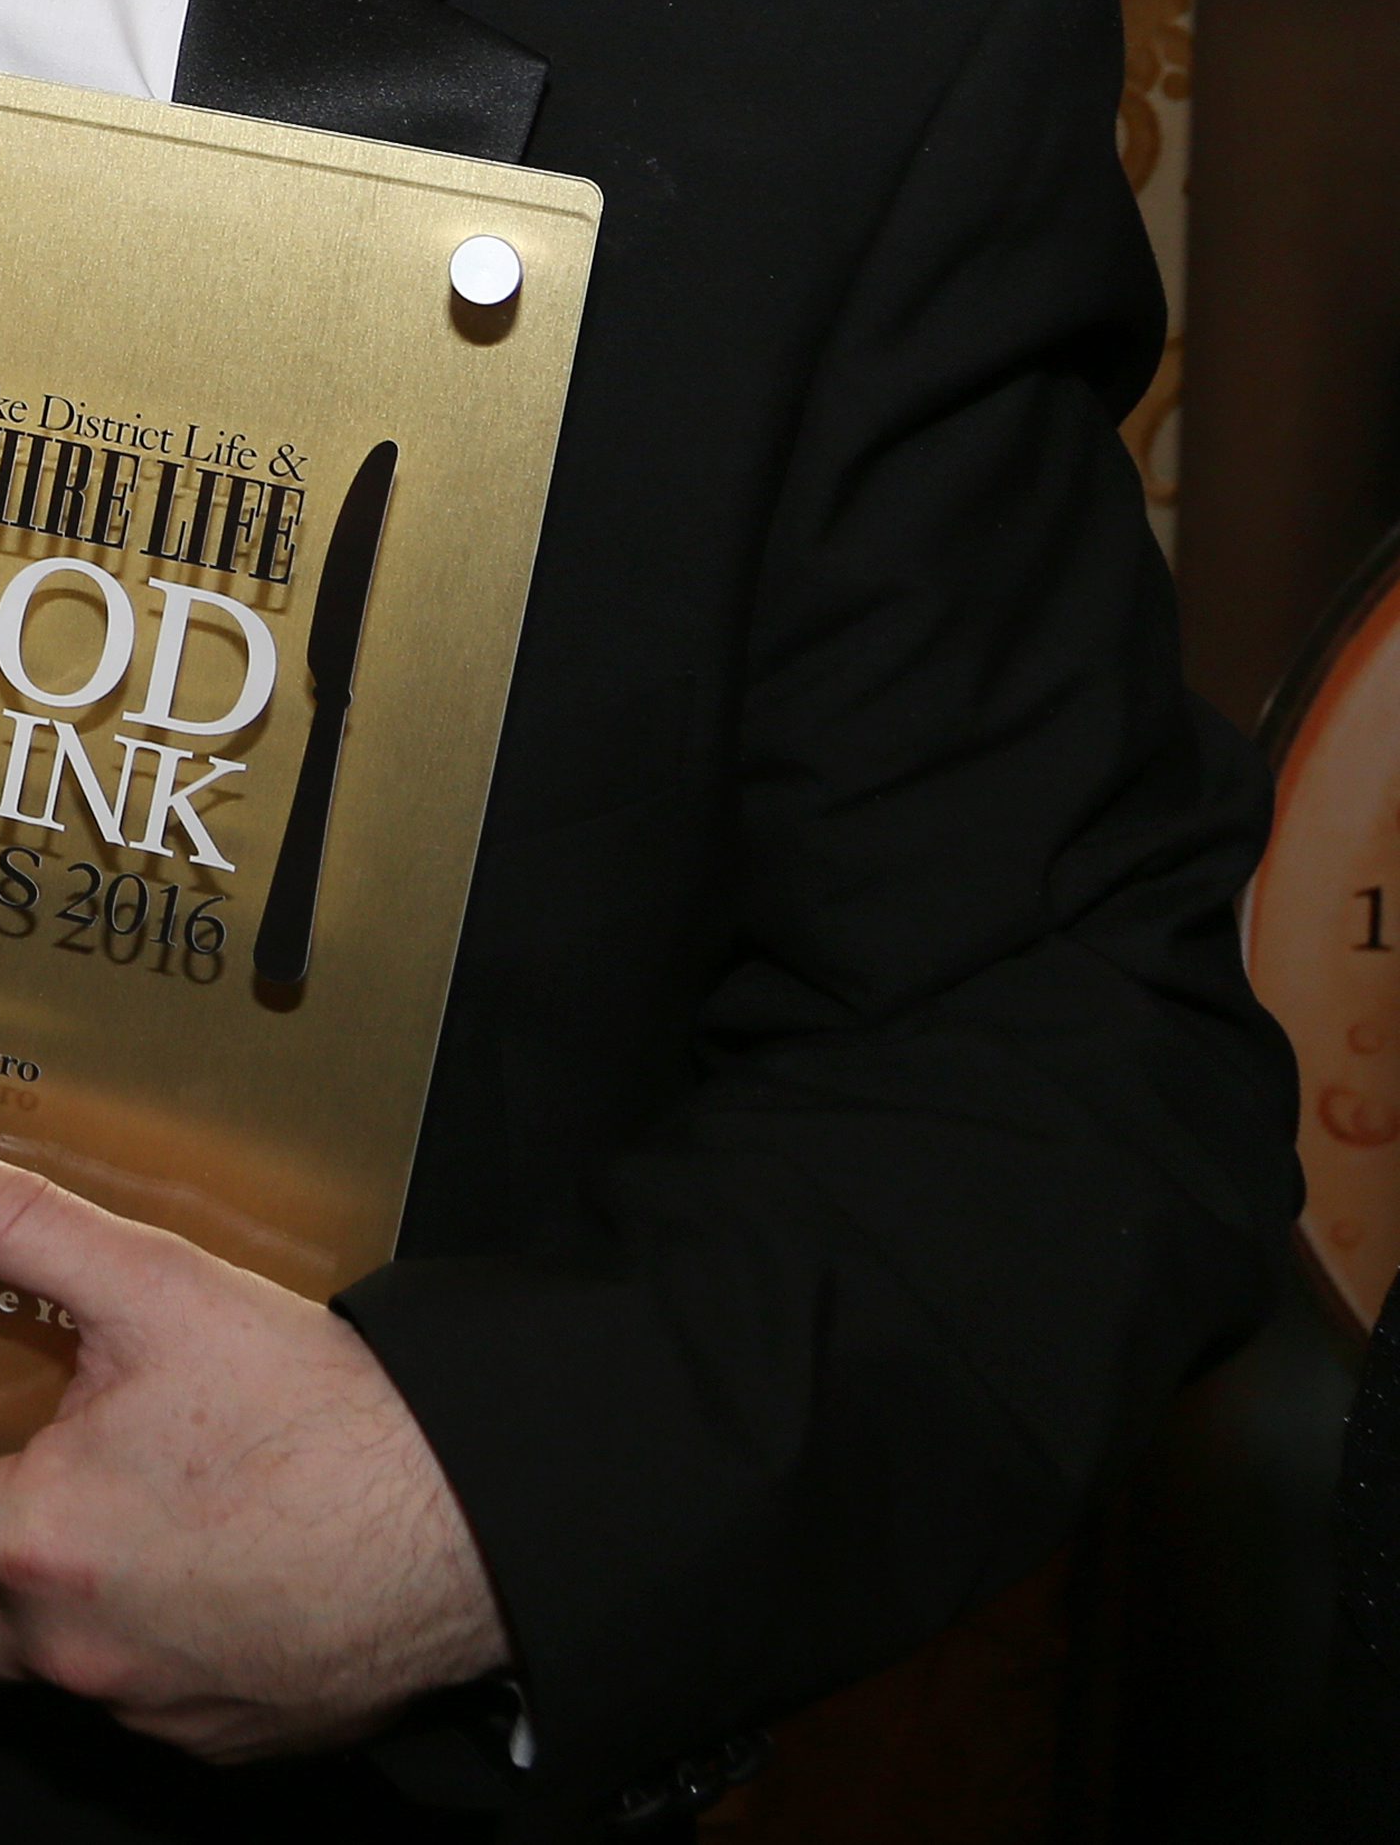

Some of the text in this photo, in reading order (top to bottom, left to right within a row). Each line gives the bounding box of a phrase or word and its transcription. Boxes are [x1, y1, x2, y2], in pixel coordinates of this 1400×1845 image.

[39, 397, 176, 456] District
[183, 423, 260, 469] Life
[267, 442, 309, 483] &
[140, 460, 306, 586] LIFE
[55, 861, 228, 957] 2016
